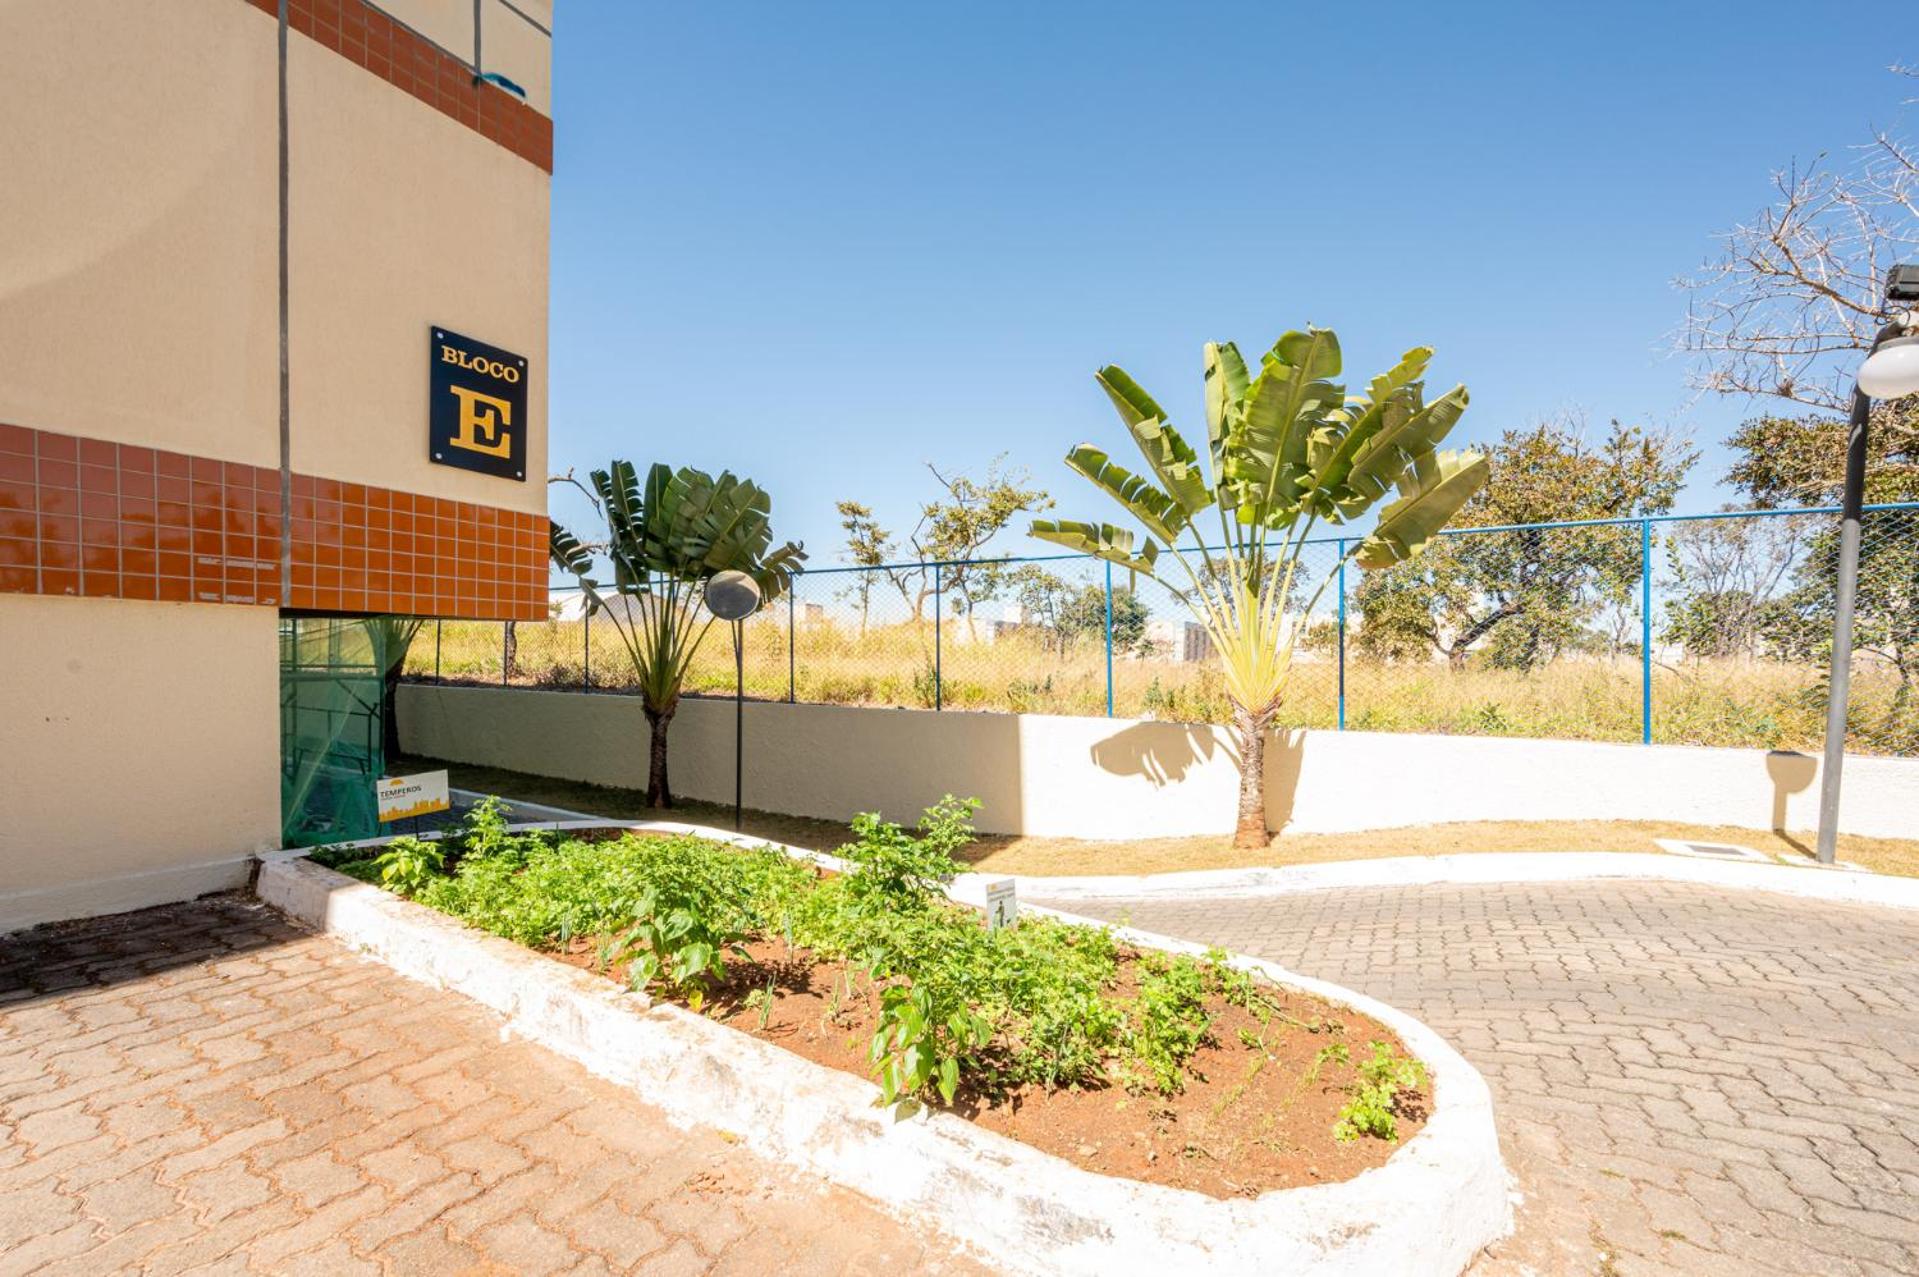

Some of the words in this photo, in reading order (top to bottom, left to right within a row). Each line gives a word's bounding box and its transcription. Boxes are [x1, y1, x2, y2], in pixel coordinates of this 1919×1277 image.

[441, 345, 520, 383] BLOCO
[450, 385, 512, 459] E
[380, 785, 422, 798] TEMPEROS
